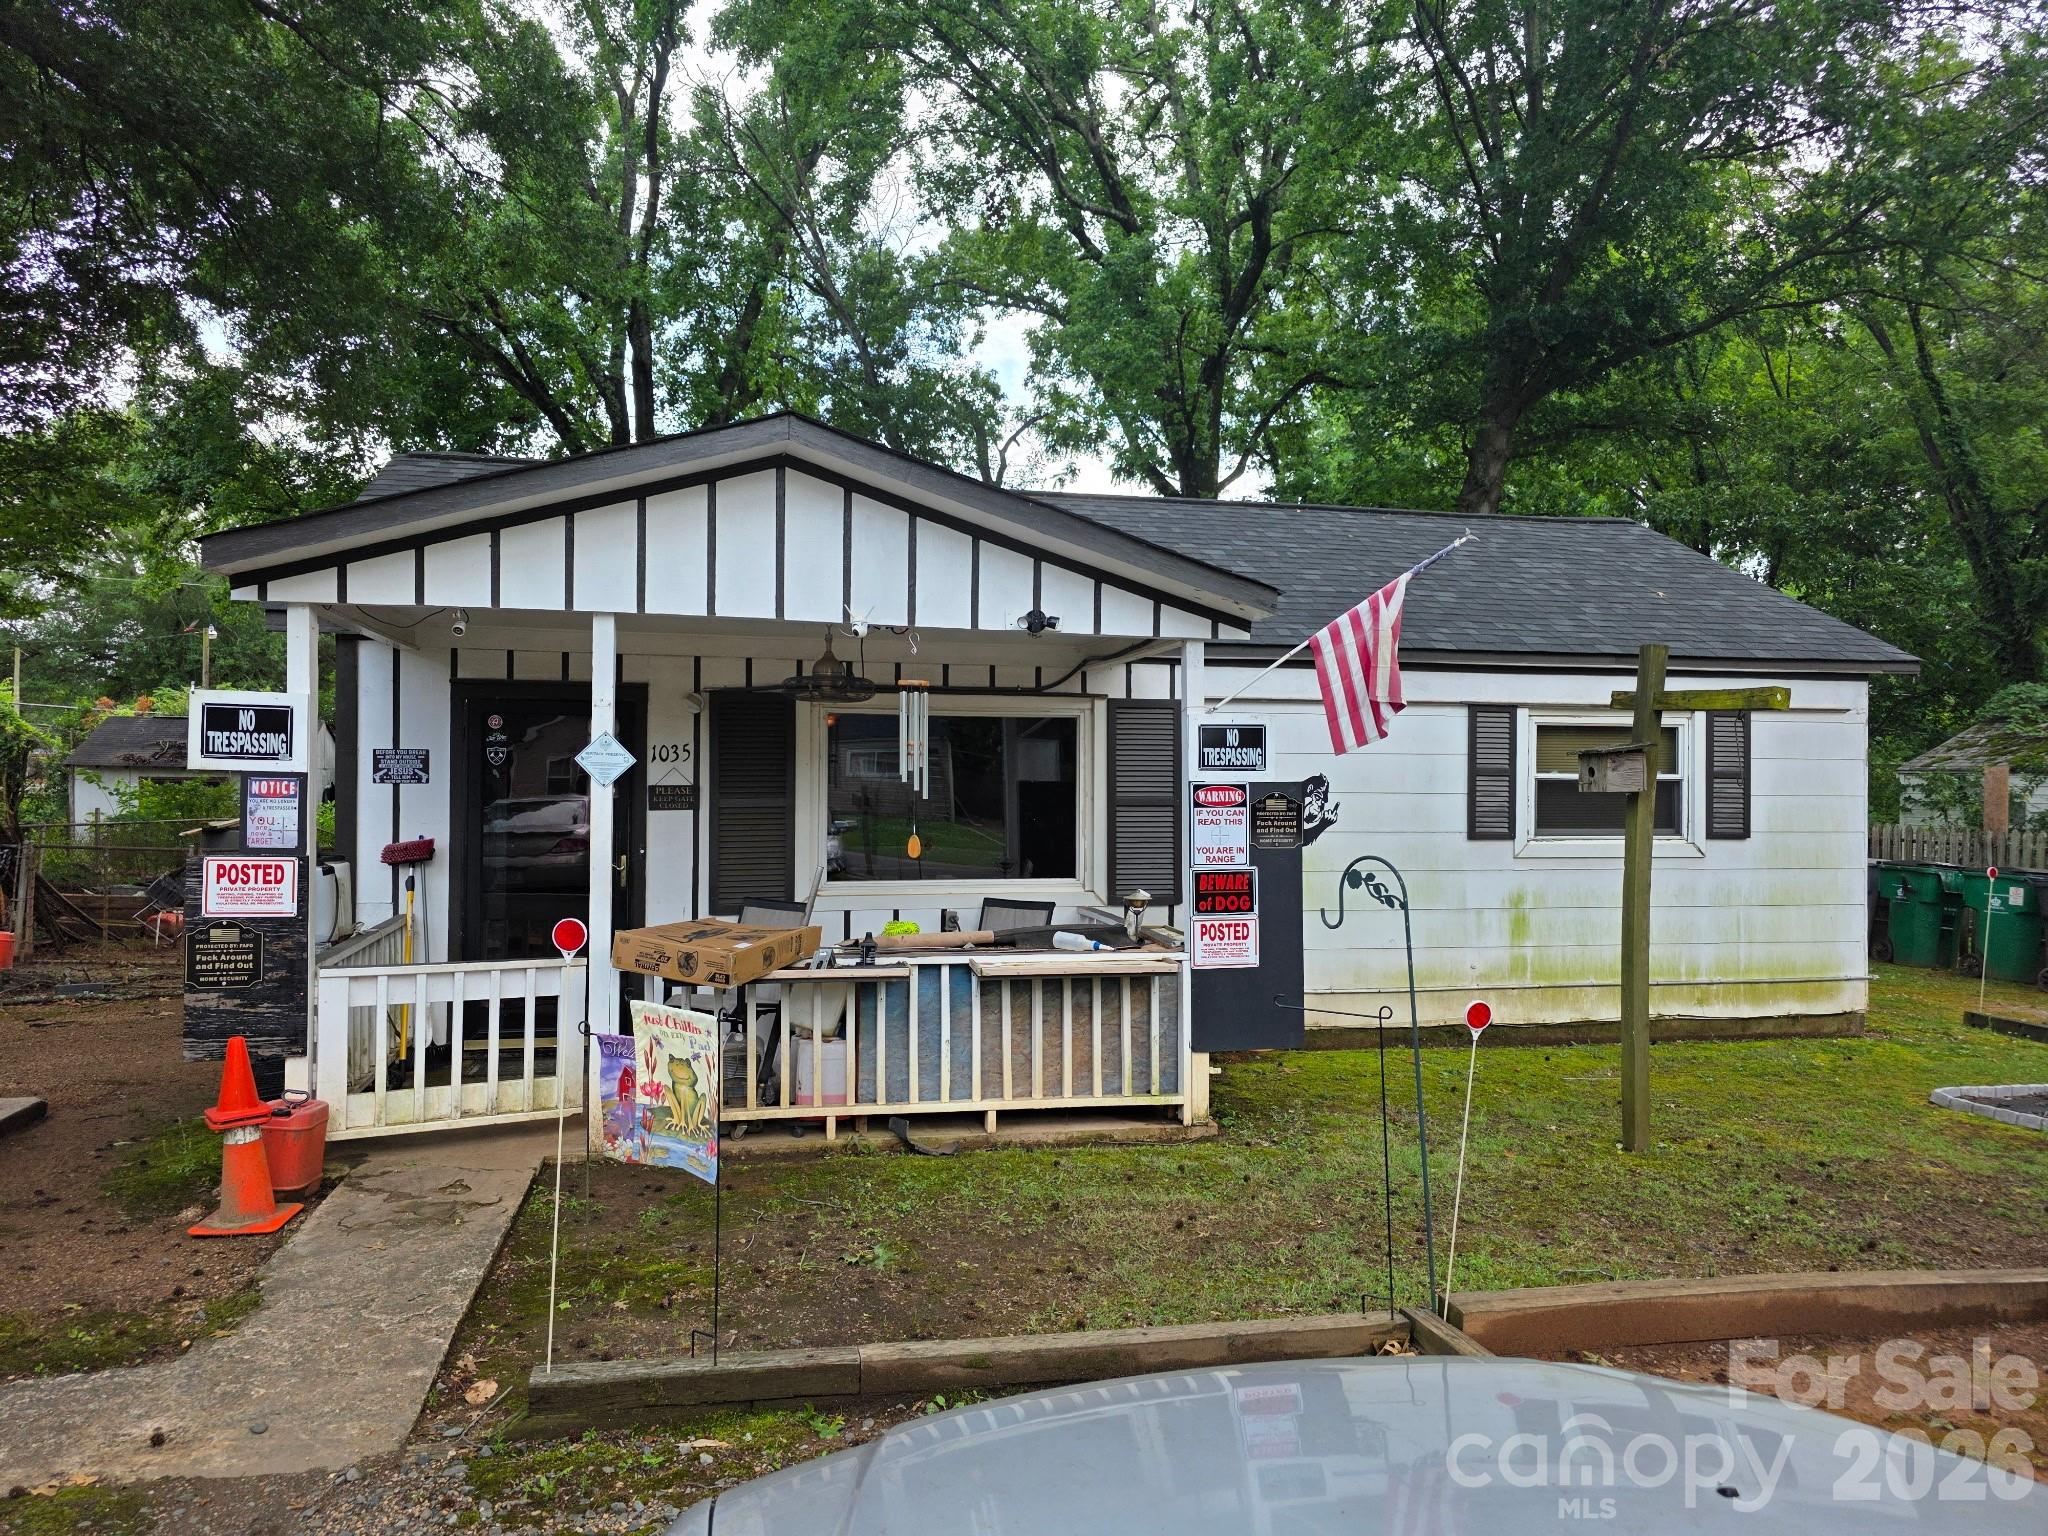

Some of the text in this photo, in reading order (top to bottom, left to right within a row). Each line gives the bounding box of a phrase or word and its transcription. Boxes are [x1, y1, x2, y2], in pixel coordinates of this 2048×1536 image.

[239, 709, 256, 731] NO
[207, 730, 287, 754] TRESPASSING
[1226, 728, 1239, 747] NO
[651, 743, 691, 763] 1035
[1203, 747, 1262, 766] TRESPASSING
[251, 780, 296, 795] NOTICE
[656, 786, 693, 795] PLEASE
[1198, 790, 1242, 803] WARNING
[1196, 809, 1245, 817] IF YOU CAN
[249, 816, 275, 826] YOU
[1197, 818, 1243, 826] READ THIS
[247, 837, 273, 845] TARGET
[1196, 846, 1245, 855] YOU ARE IN
[1205, 855, 1236, 864] RANGE
[216, 863, 285, 885] POSTED
[1199, 873, 1250, 891] BEWARE
[1198, 895, 1251, 911] of DOG
[1200, 922, 1250, 942] POSTED
[196, 953, 253, 962] Fuck Around
[195, 962, 213, 970] and
[215, 962, 235, 970] Find
[634, 960, 660, 973] CENTRAL
[688, 1035, 711, 1051] Pad
